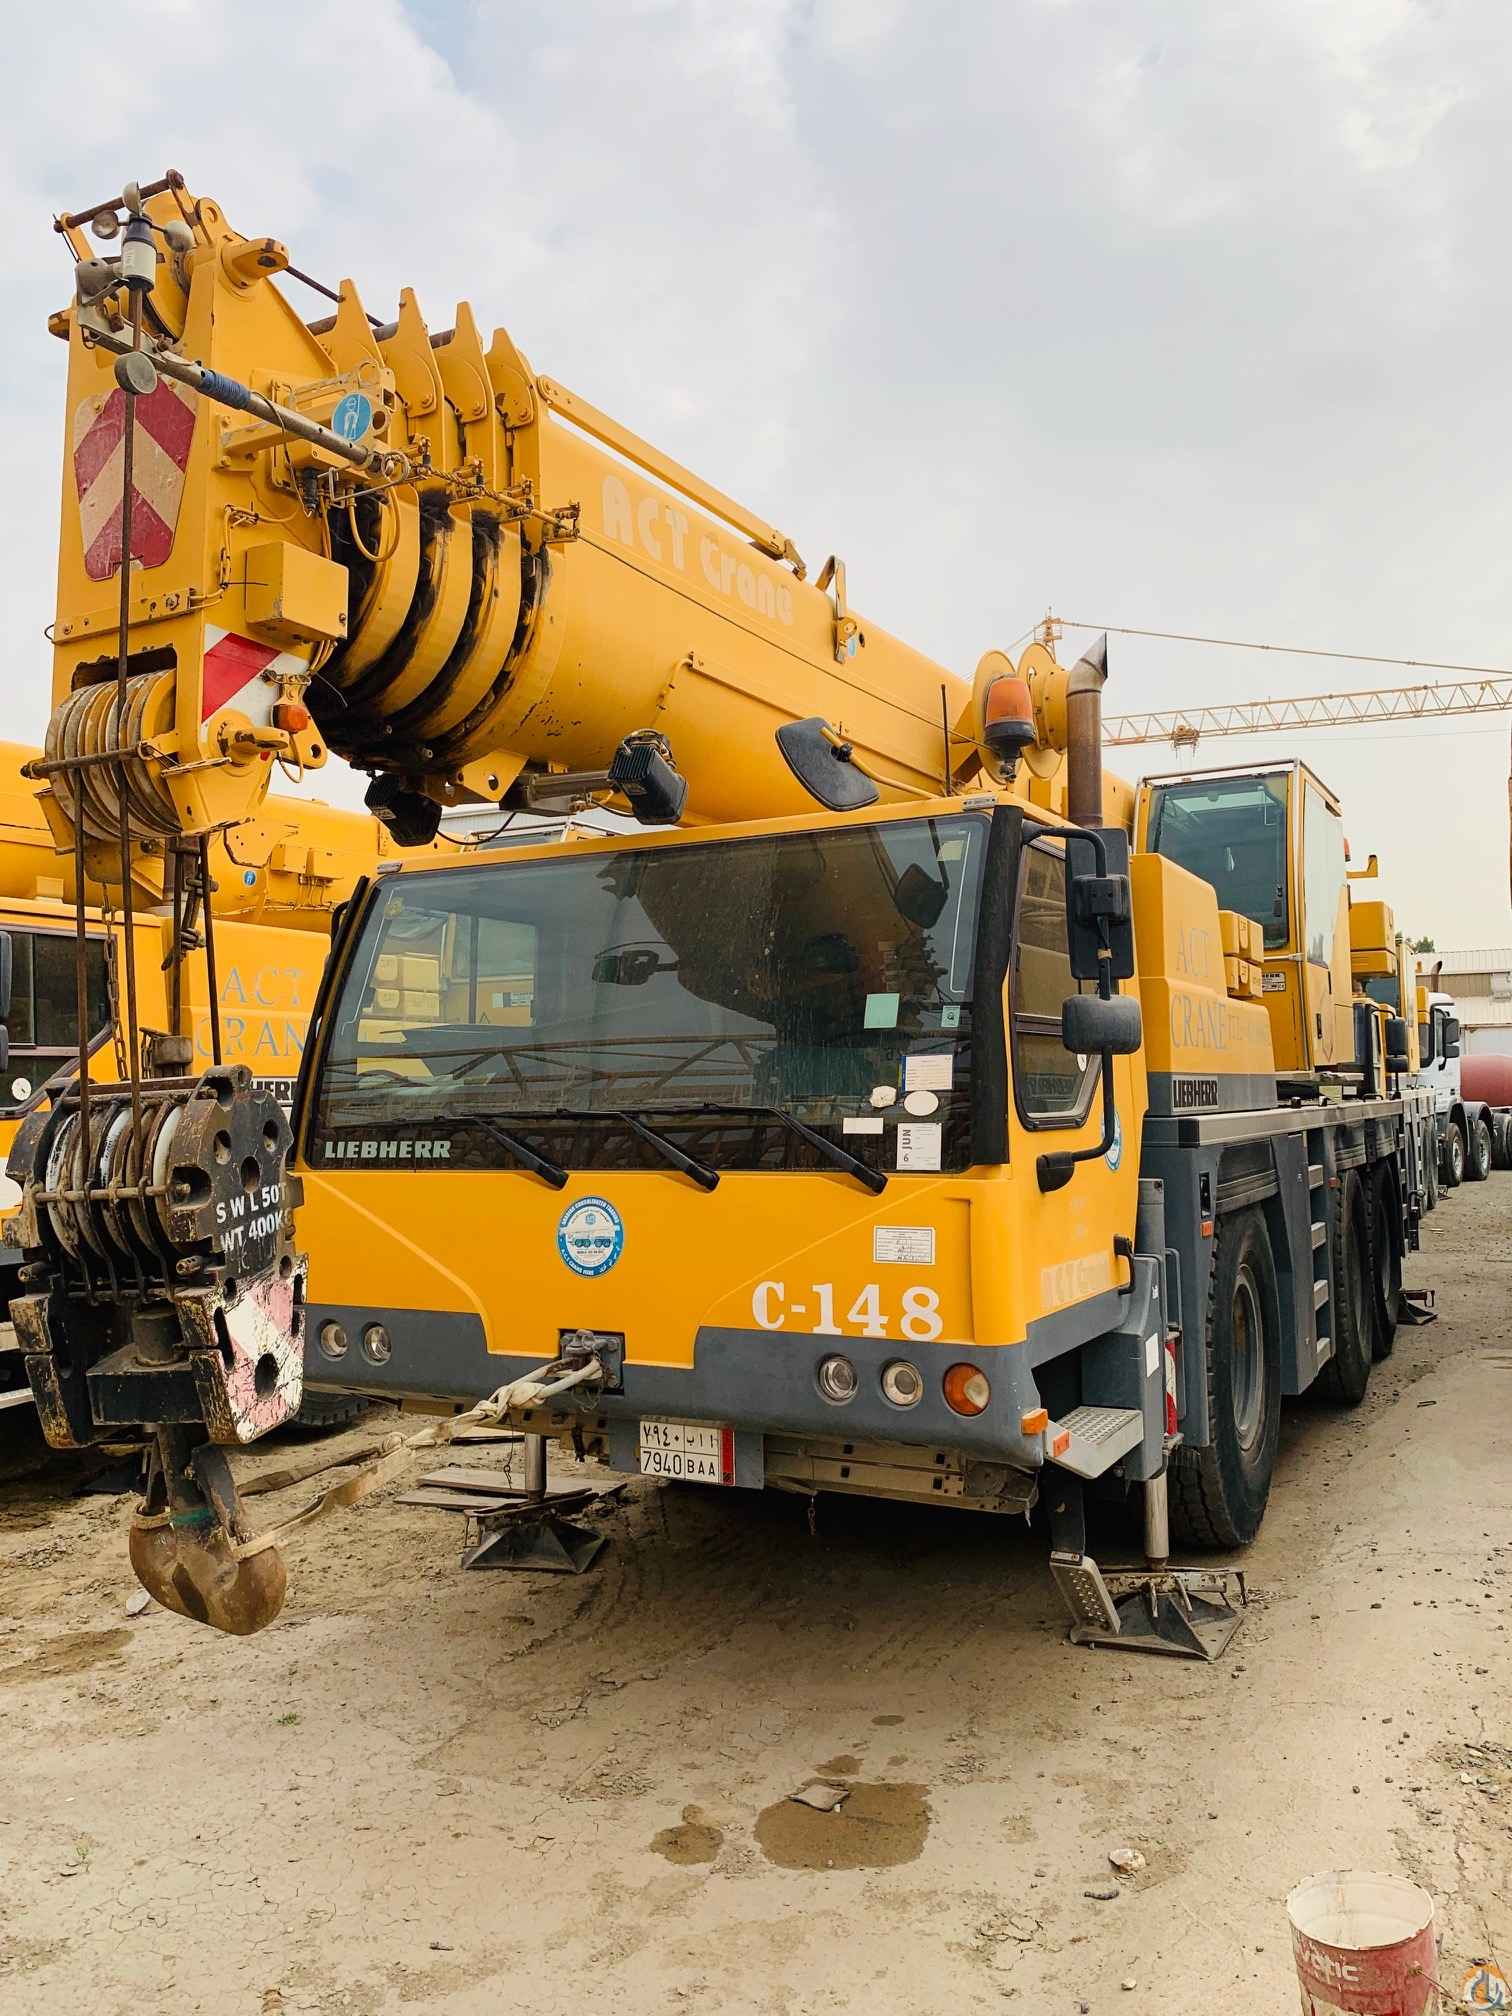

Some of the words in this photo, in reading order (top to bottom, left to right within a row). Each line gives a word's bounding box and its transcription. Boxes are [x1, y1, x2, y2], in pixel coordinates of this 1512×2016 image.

[602, 475, 688, 571] ACT
[196, 1015, 305, 1057] CRAN
[1173, 1079, 1218, 1108] LIEBHERR
[325, 1141, 451, 1158] LIEBHERR
[752, 1281, 943, 1341] C-148
[643, 1451, 682, 1475] 7940
